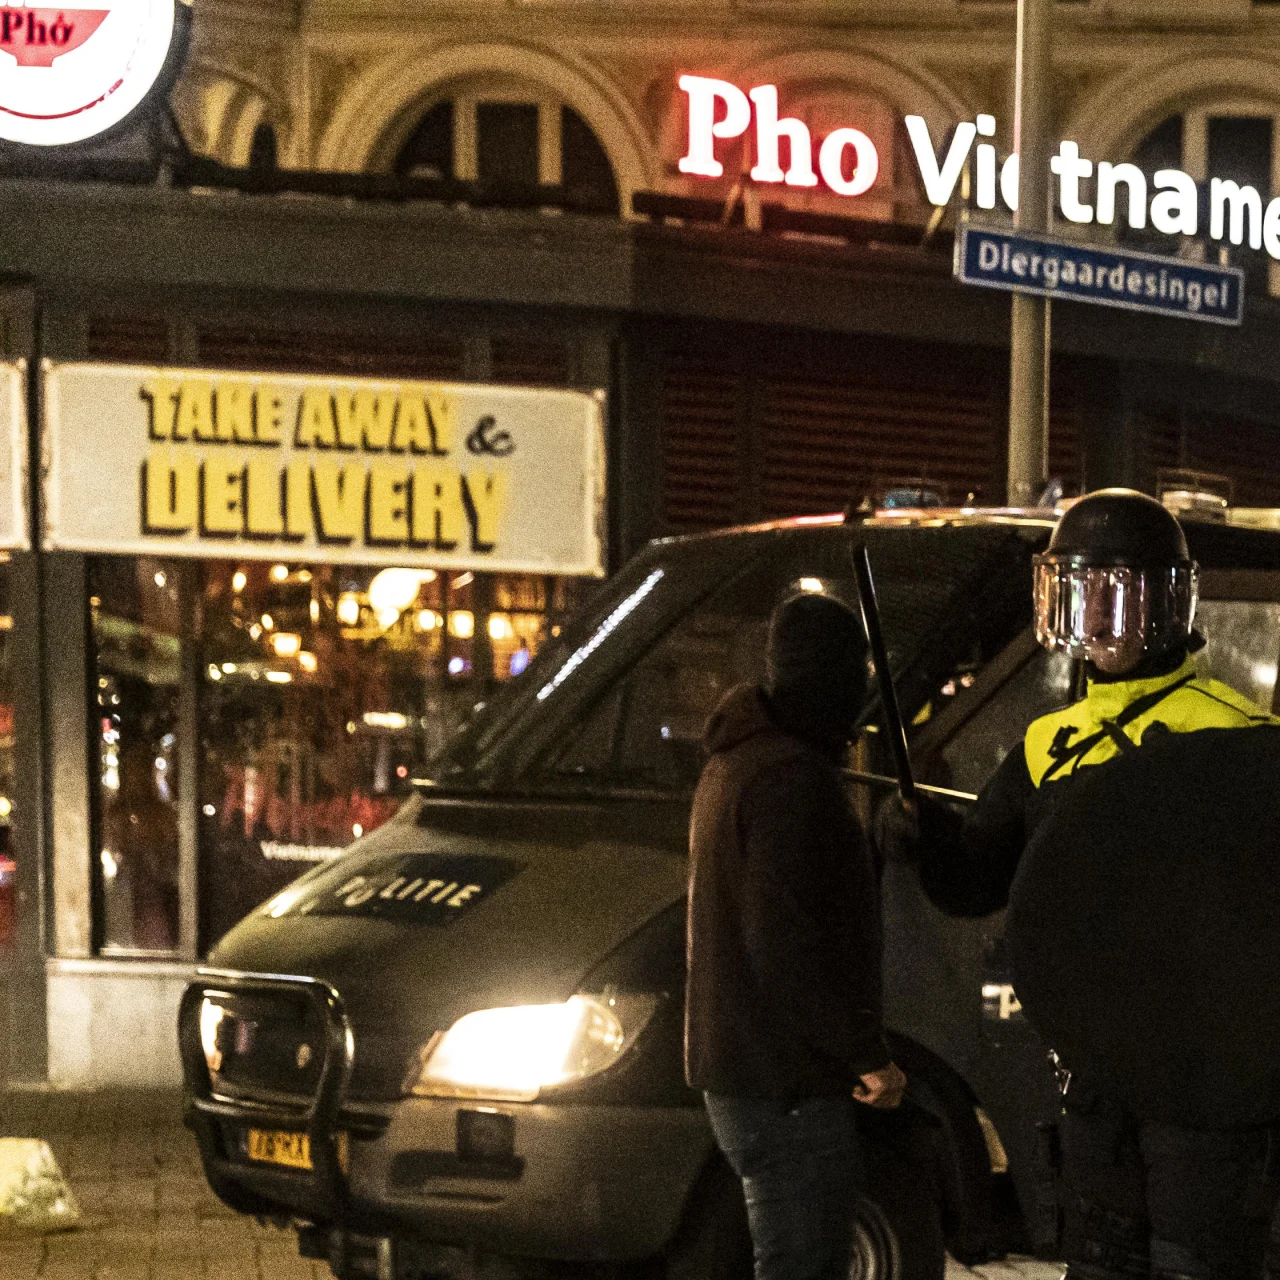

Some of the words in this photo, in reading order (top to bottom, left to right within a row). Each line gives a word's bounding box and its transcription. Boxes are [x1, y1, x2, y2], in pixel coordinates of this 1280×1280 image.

[678, 74, 879, 196] Pho
[978, 239, 1230, 312] Diergaardesingel
[139, 374, 284, 448] TAKE
[293, 383, 456, 456] AWAY
[465, 414, 516, 457] &
[139, 449, 510, 554] DELIVERY
